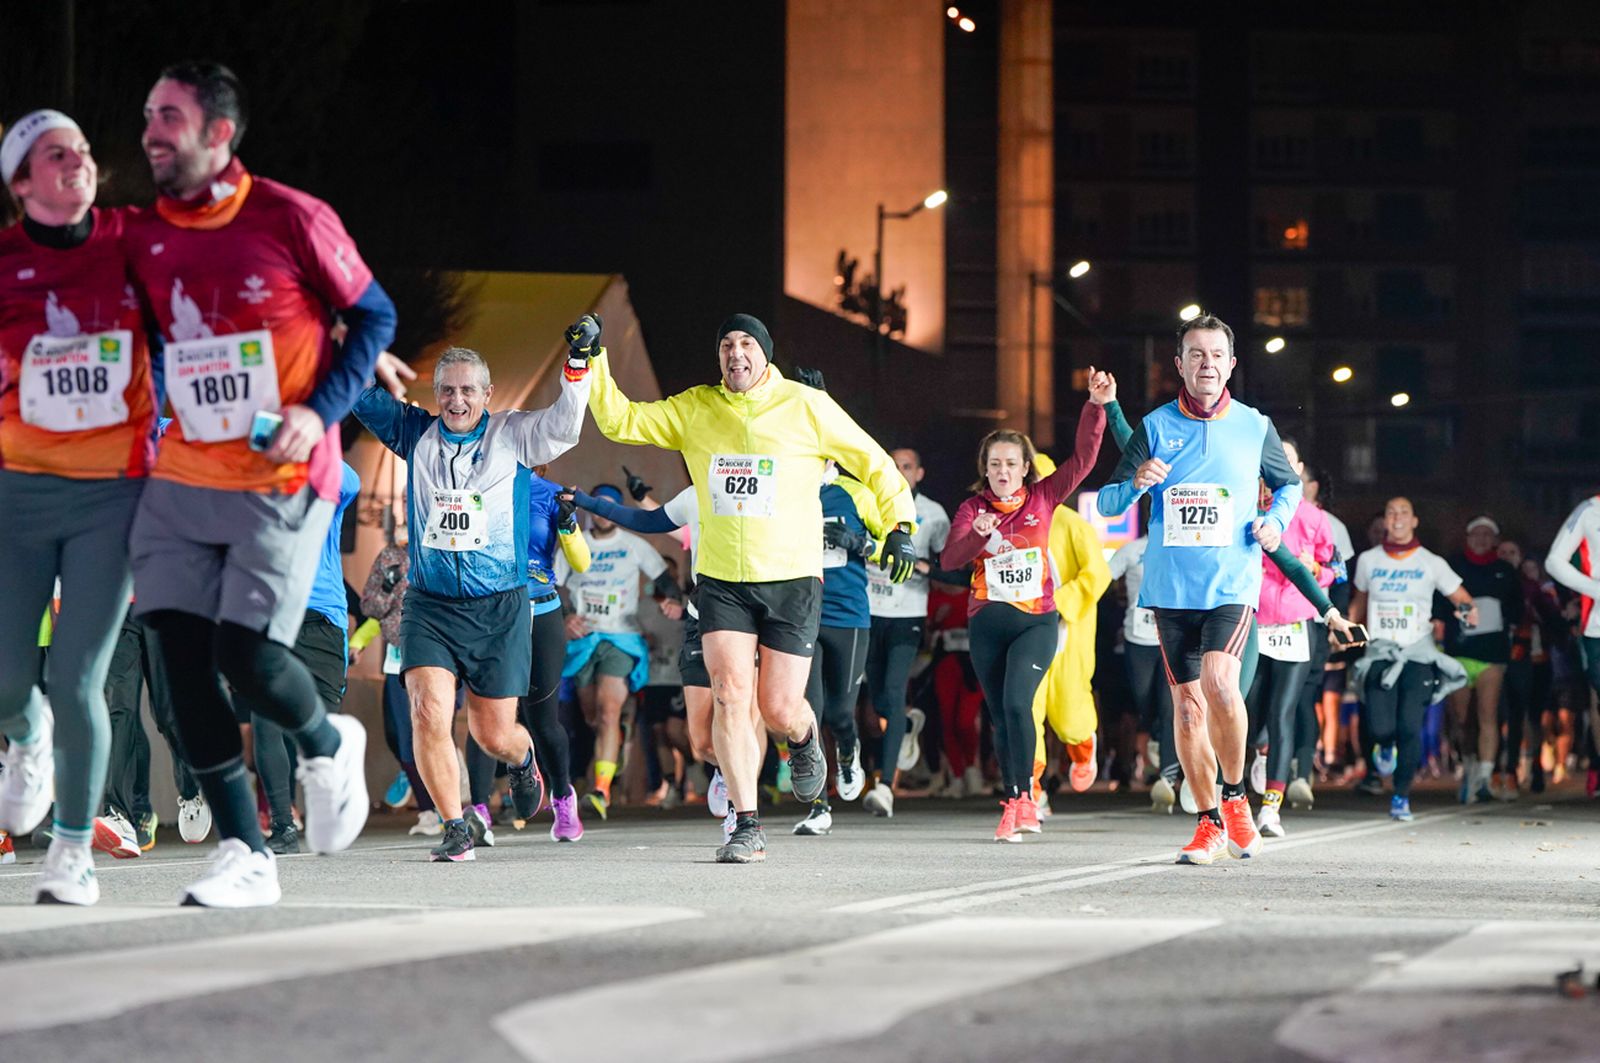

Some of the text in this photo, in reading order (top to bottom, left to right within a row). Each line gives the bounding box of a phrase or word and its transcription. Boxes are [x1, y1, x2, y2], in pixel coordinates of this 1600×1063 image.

[43, 367, 109, 396] 1808
[190, 373, 250, 406] 1807
[725, 476, 758, 495] 628
[439, 512, 470, 530] 200
[1178, 506, 1219, 525] 1275
[998, 567, 1033, 584] 1538
[1371, 568, 1388, 580] SAN
[1380, 618, 1408, 629] 6570
[1268, 635, 1291, 647] 574
